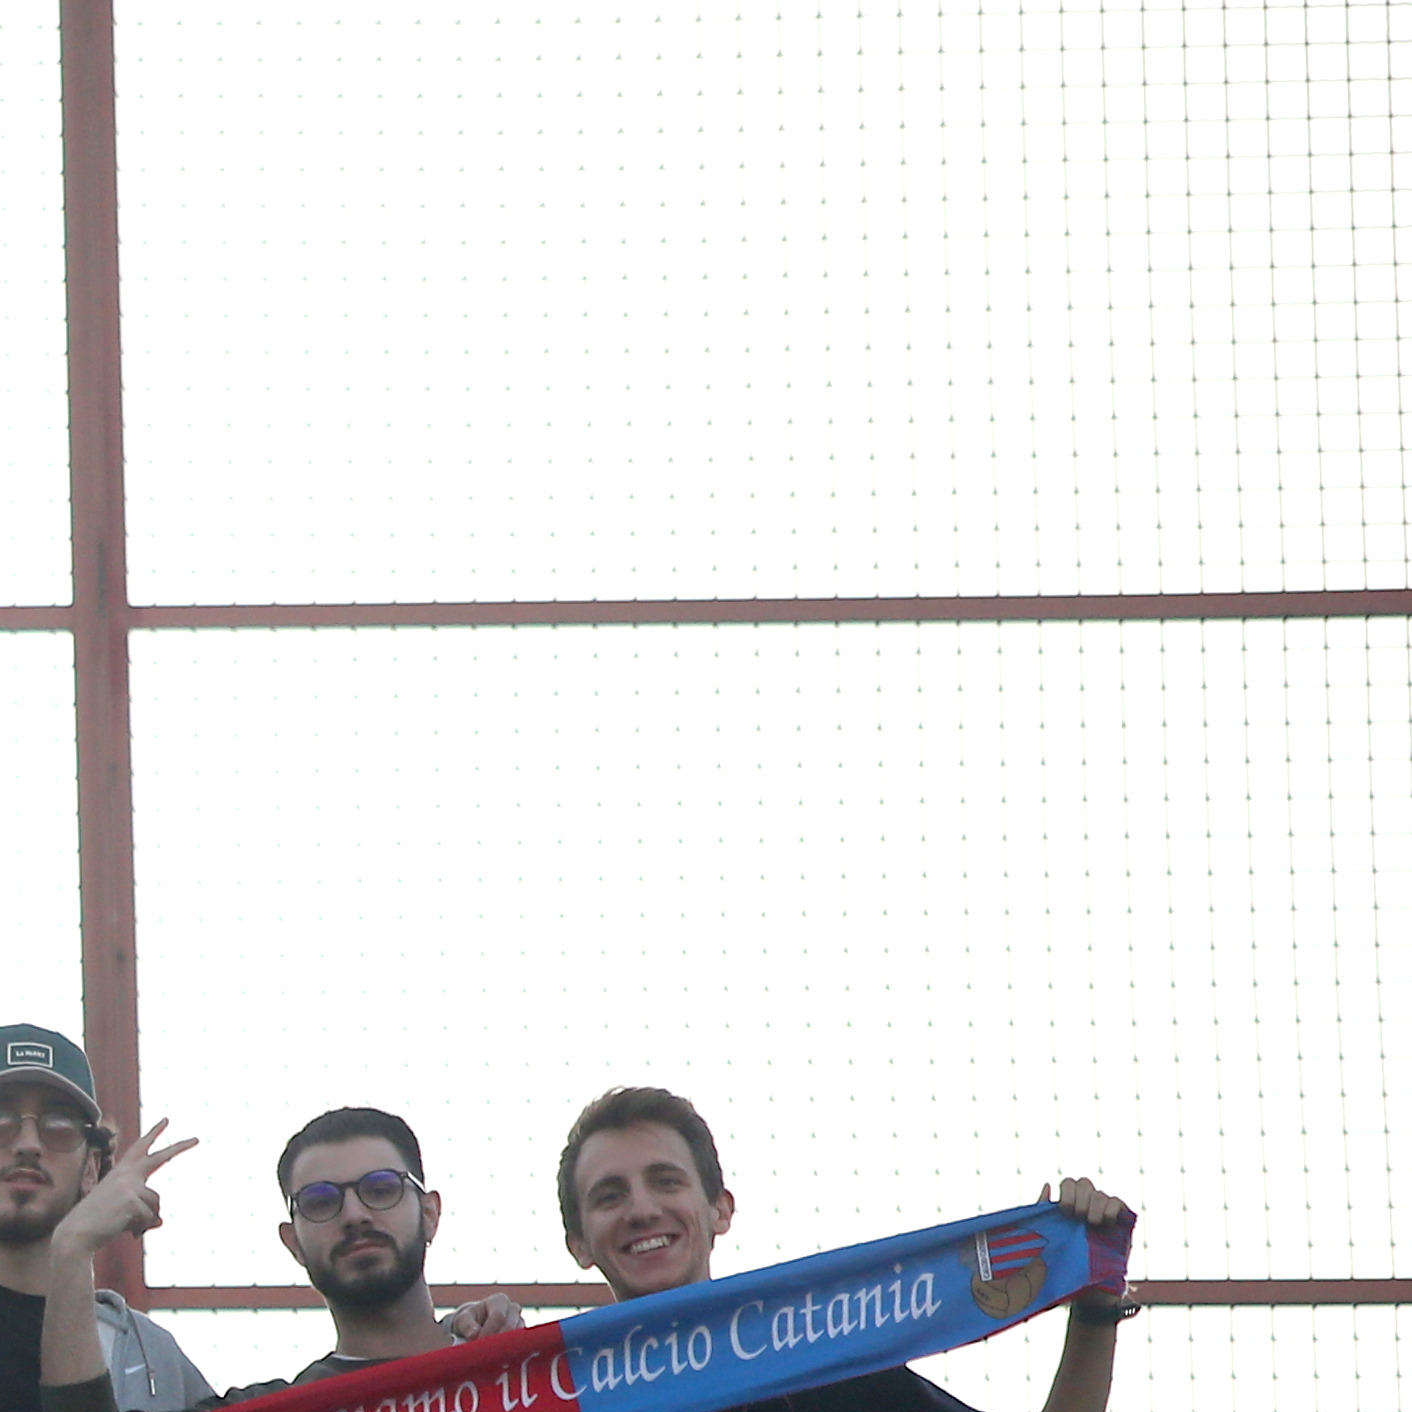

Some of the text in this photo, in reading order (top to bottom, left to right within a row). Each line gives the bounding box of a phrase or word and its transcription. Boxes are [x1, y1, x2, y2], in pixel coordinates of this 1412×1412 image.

[496, 1351, 541, 1412] il
[550, 1319, 714, 1401] Calcio
[729, 1262, 943, 1361] Catania
